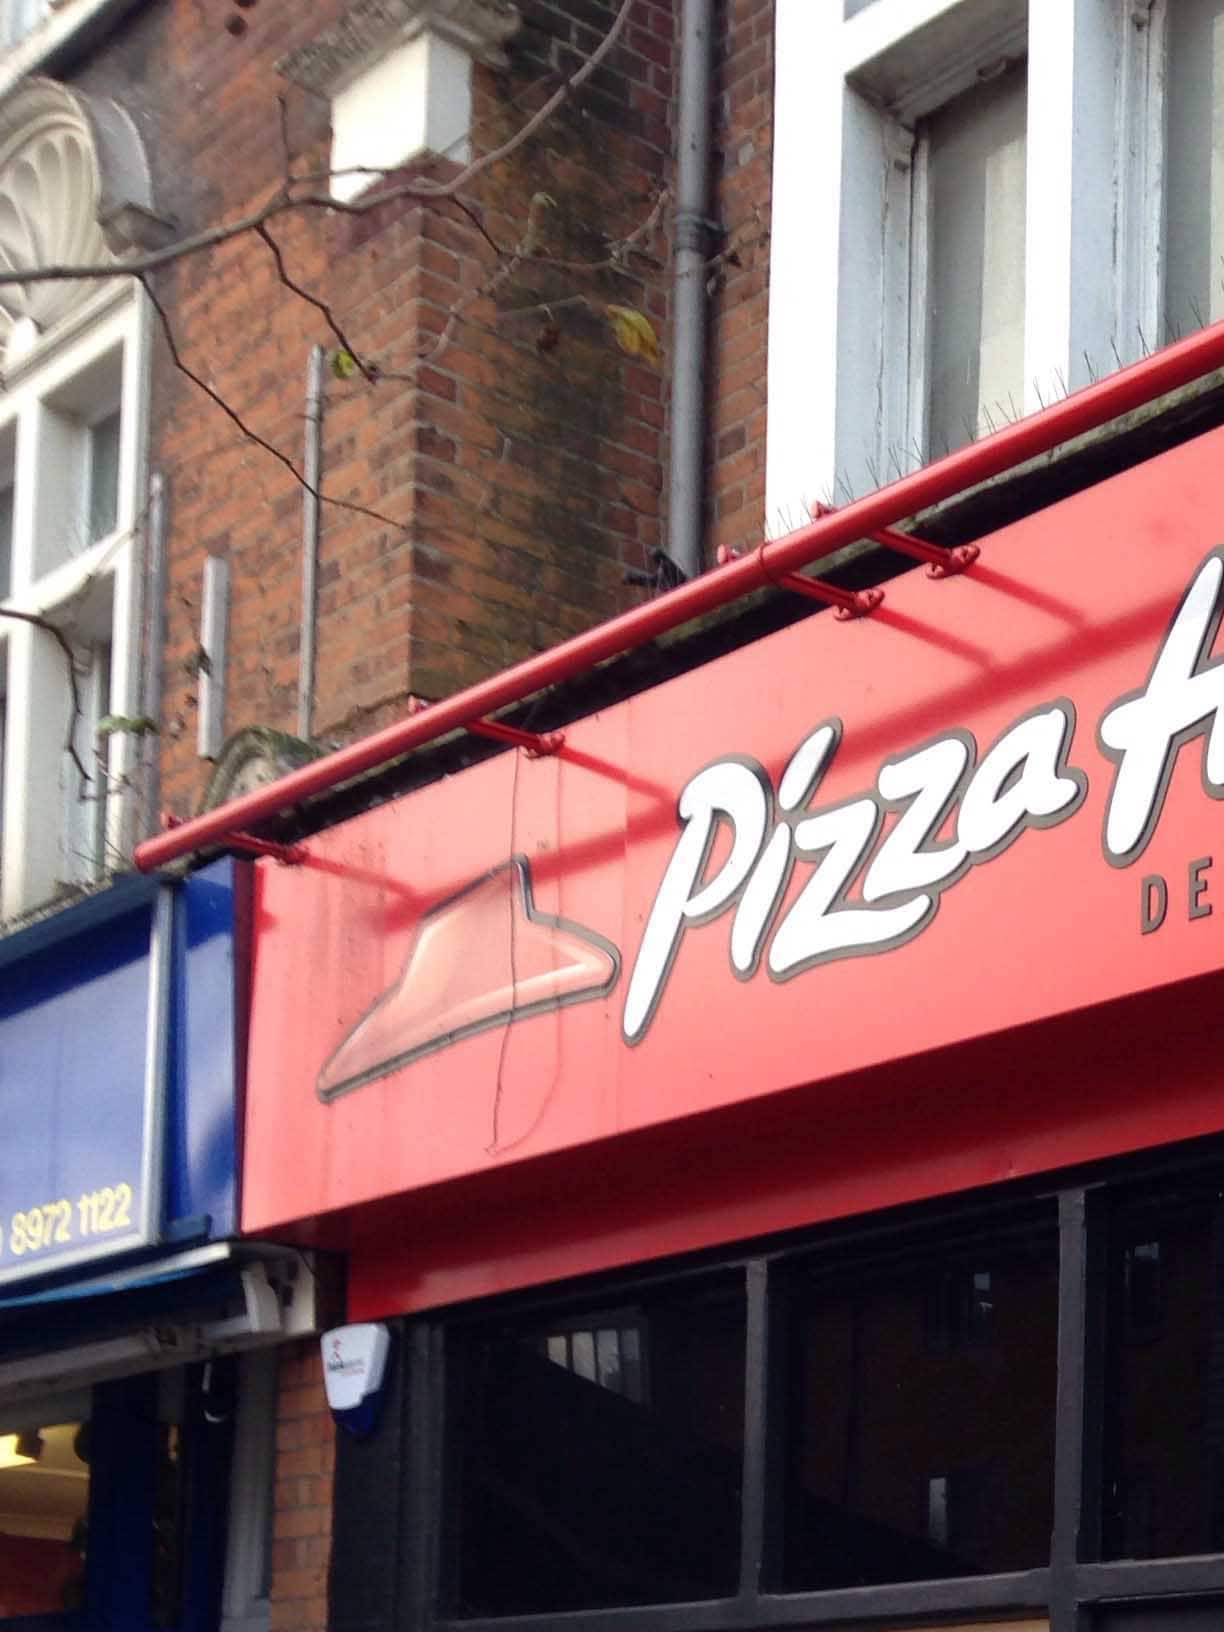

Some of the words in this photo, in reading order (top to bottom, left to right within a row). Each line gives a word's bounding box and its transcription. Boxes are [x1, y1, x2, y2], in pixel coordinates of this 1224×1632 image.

[621, 697, 1086, 1043] Pizza
[10, 1211, 71, 1256] 8972
[78, 1182, 132, 1236] 1122
